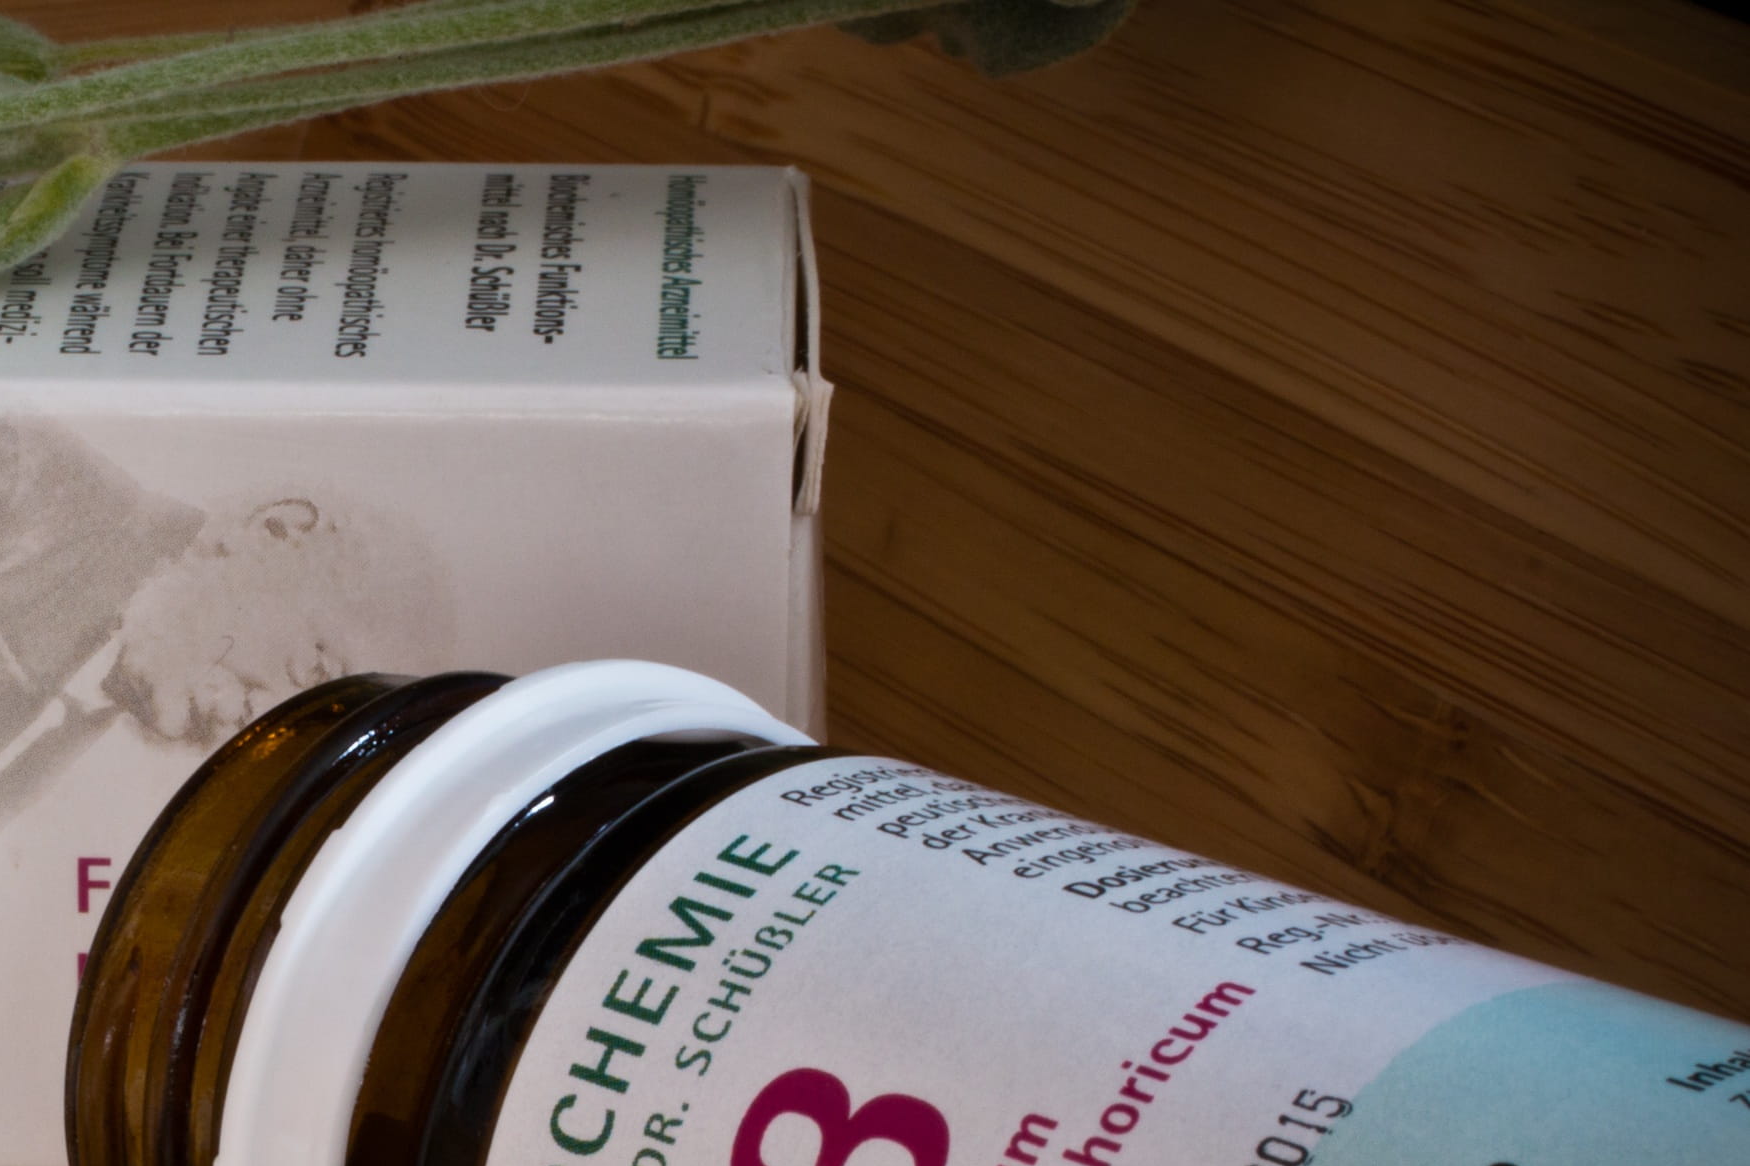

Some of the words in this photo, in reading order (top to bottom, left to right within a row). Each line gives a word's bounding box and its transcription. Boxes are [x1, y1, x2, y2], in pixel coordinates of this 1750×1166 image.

[158, 172, 216, 229] Indikation.
[223, 172, 280, 212] Angabe
[281, 172, 343, 242] Arzneimittel,
[353, 172, 409, 238] Registriertes
[481, 173, 525, 208] mittel
[73, 172, 150, 289] Krankheitssymptome
[153, 230, 199, 250] Bei
[221, 213, 268, 242] einer
[476, 210, 519, 240] nach
[540, 174, 592, 260] Biochemisches
[654, 174, 707, 273] Homöopathisches
[9, 262, 53, 286] soll
[279, 244, 327, 283] daher
[473, 243, 517, 262] Dr.
[134, 253, 194, 327] Fortdauern
[197, 245, 260, 356] therapeutischen
[271, 285, 319, 322] ohne
[334, 239, 396, 358] homöopathisches
[465, 265, 515, 333] Schüßler
[533, 263, 583, 344] Funktions-
[59, 292, 111, 354] während
[657, 275, 703, 360] Arzneimittel
[128, 330, 174, 357] der
[921, 823, 979, 850] der
[1171, 906, 1239, 935] Für
[1299, 936, 1408, 976] Nicht
